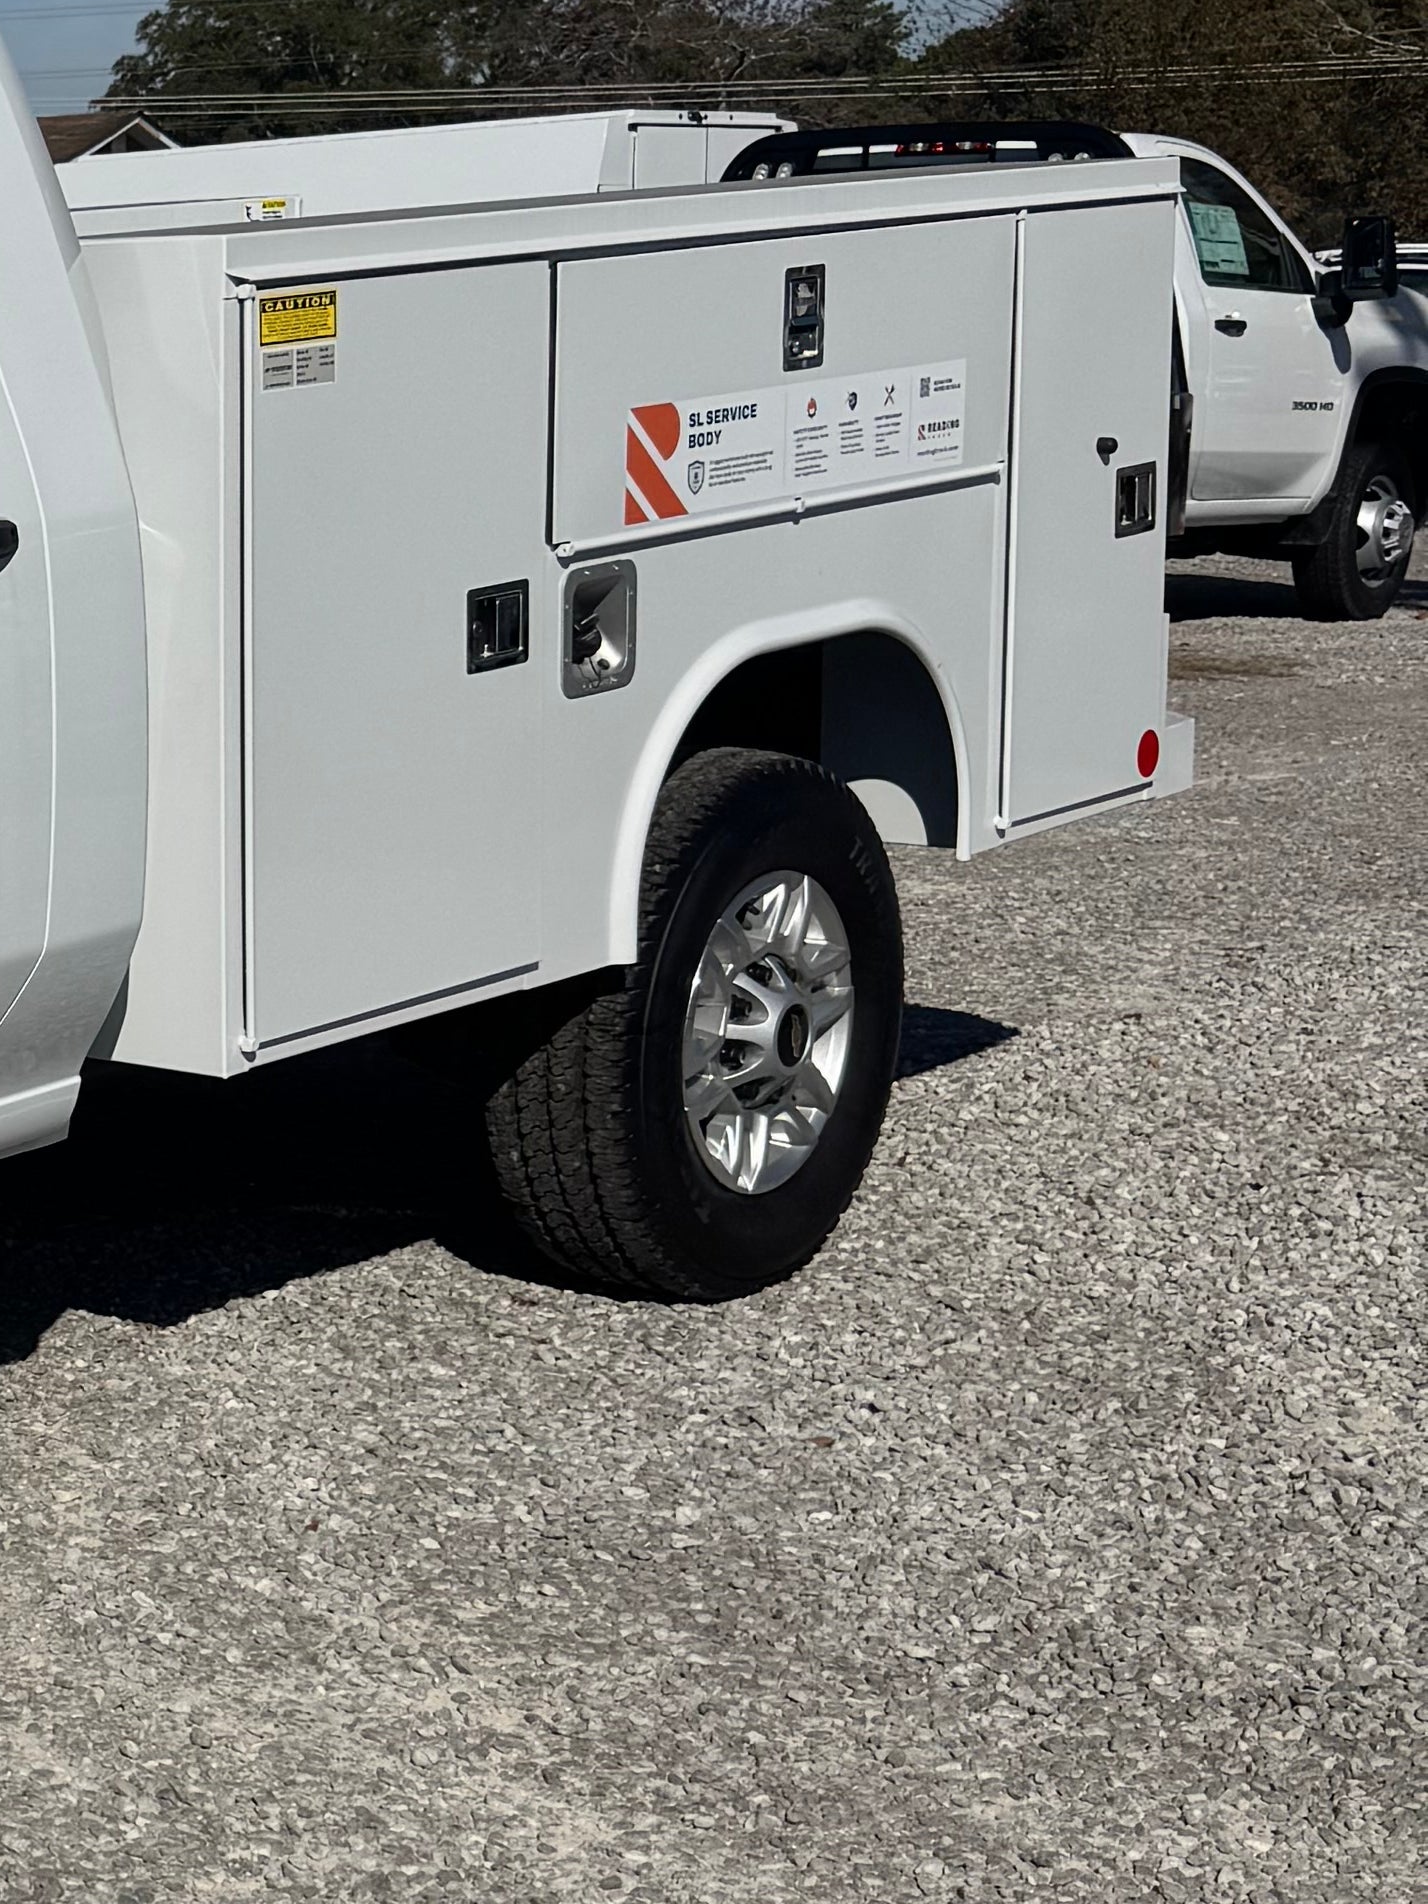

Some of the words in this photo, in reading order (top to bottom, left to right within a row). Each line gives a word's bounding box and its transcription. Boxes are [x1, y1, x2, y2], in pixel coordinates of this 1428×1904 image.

[264, 295, 331, 313] CAUTION
[688, 411, 705, 428] SL
[706, 403, 758, 425] SERVICE
[688, 429, 722, 449] BODY
